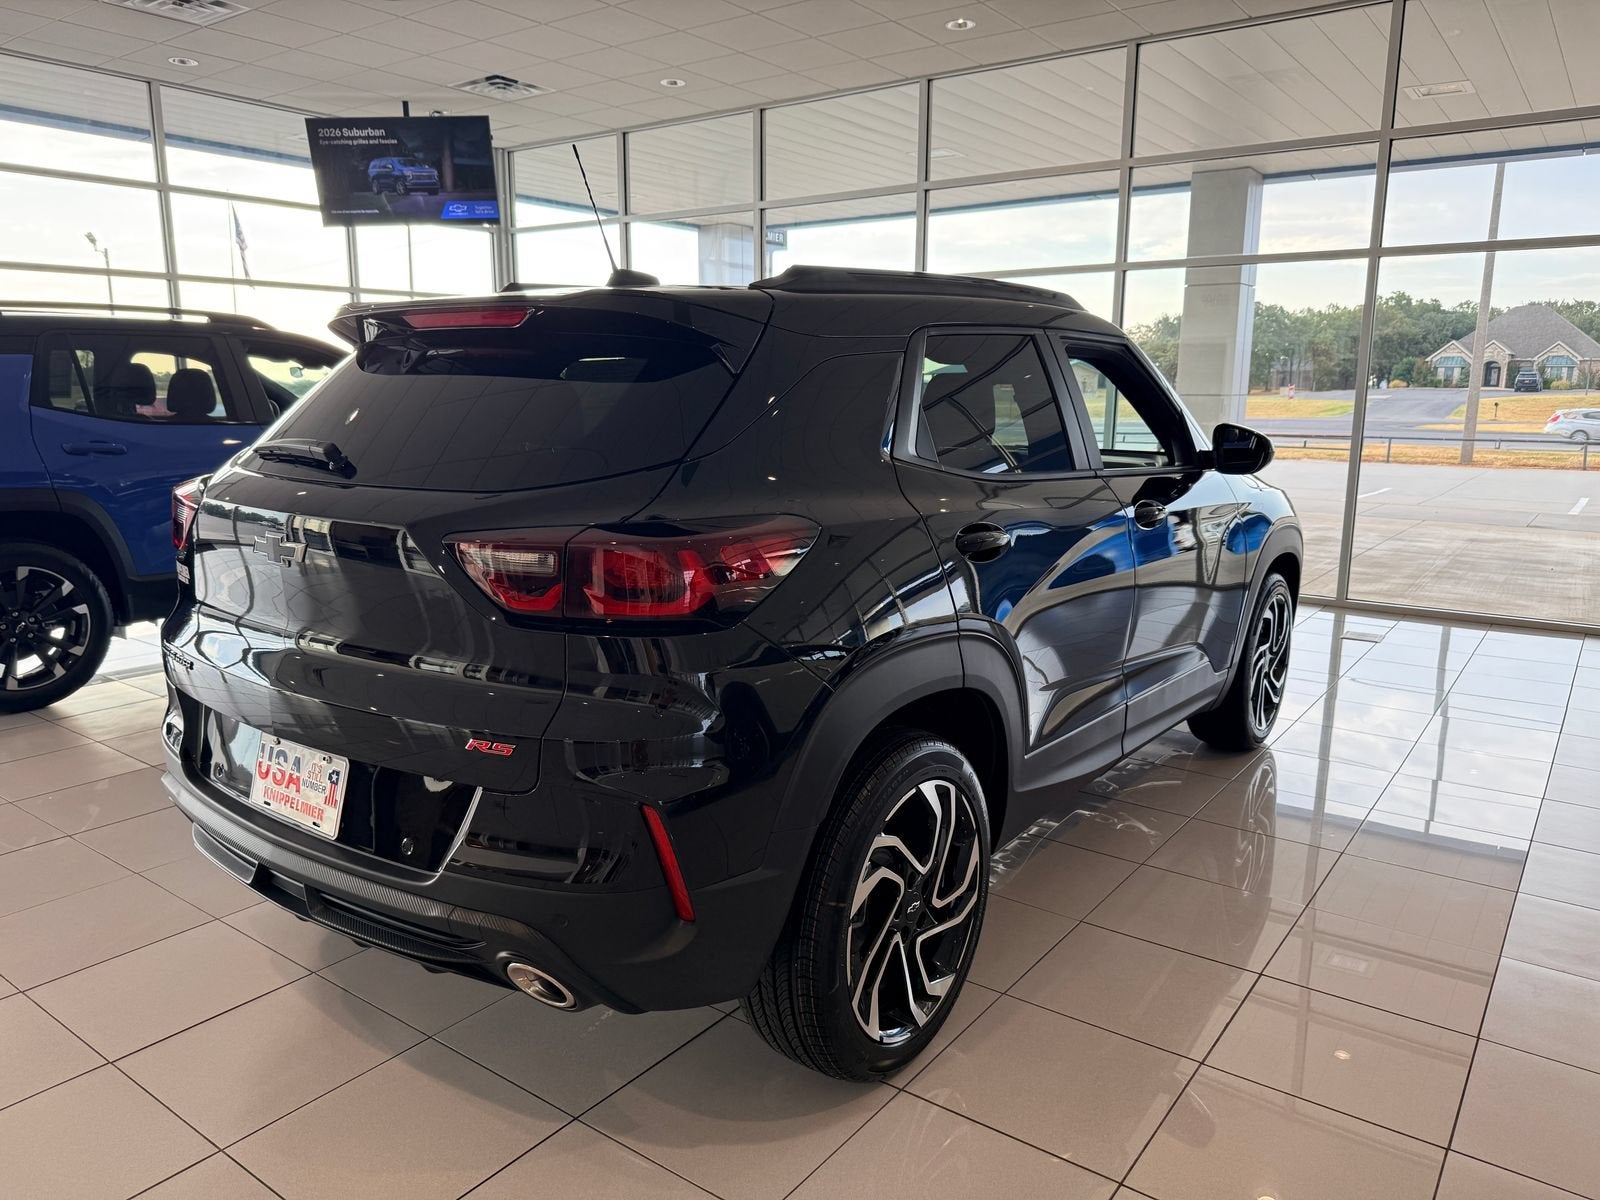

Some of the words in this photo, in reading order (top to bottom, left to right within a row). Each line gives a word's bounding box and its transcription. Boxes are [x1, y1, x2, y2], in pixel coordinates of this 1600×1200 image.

[317, 127, 341, 137] 2026
[342, 127, 386, 137] Suburban
[766, 231, 784, 242] MIER
[465, 738, 517, 755] RS
[257, 742, 301, 794] USA
[311, 762, 323, 774] IT'S
[307, 770, 323, 784] STILL
[301, 778, 327, 795] NUMBER
[263, 786, 325, 821] KNIPPELMIER
